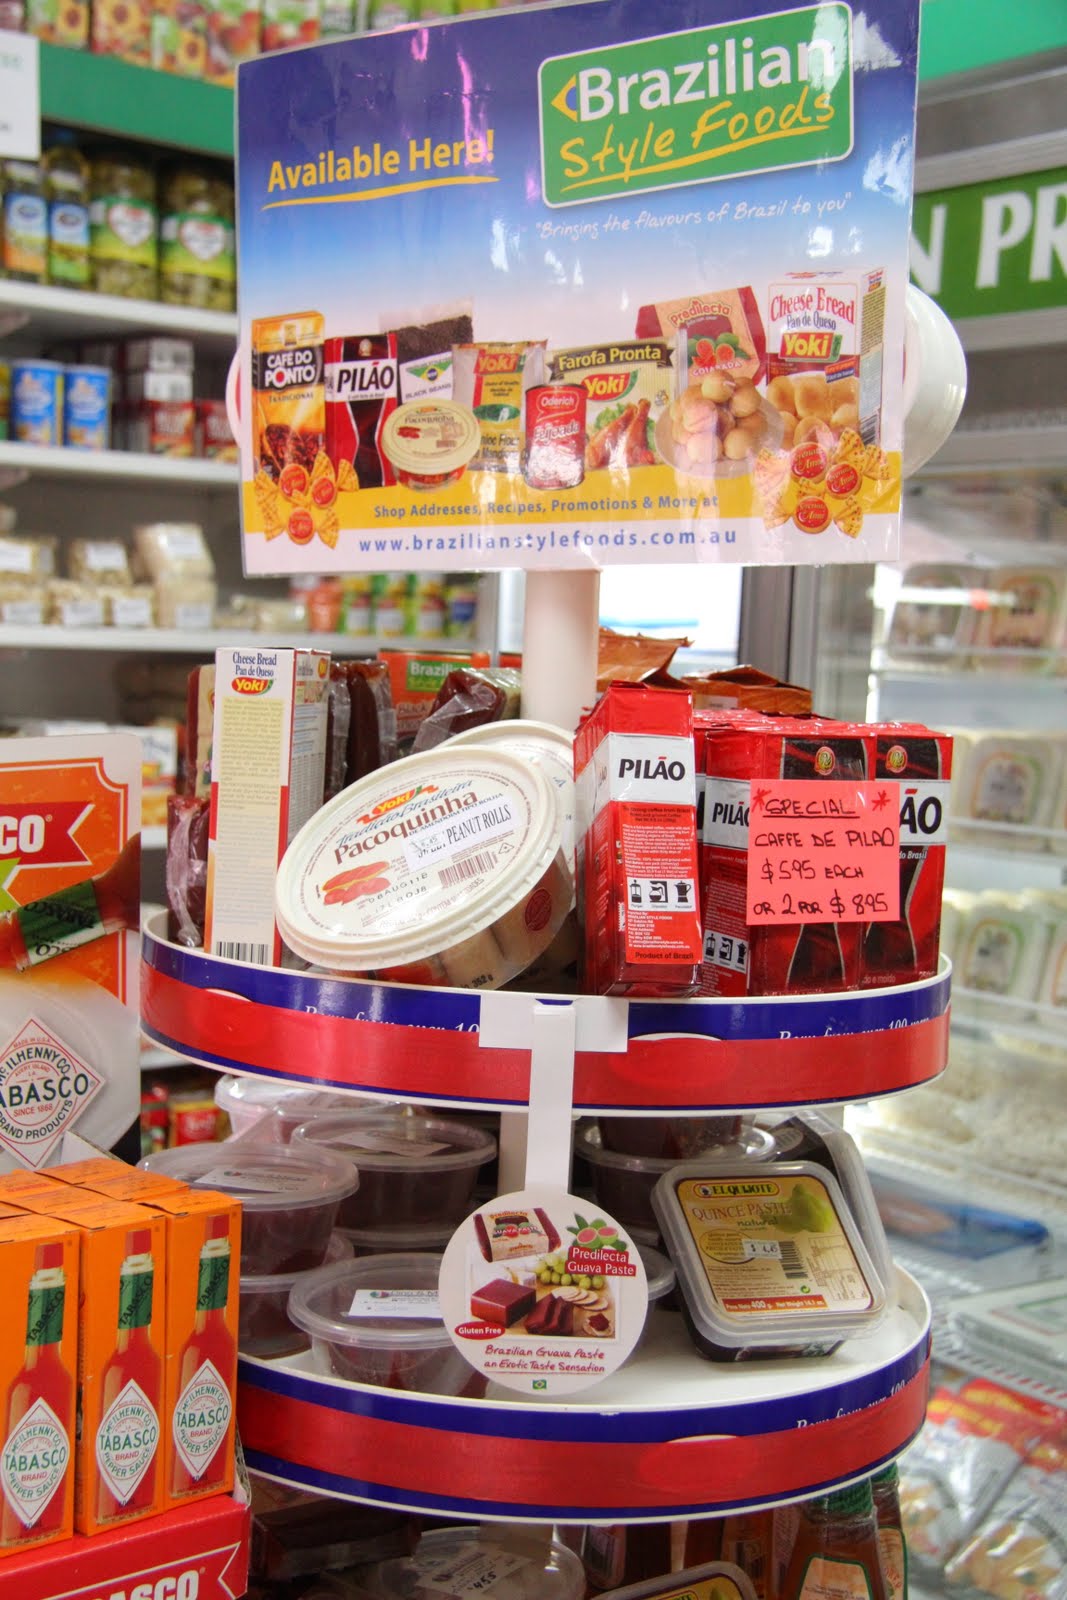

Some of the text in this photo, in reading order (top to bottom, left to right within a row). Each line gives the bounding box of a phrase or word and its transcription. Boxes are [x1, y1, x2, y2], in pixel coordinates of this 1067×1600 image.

[579, 36, 835, 121] Brazilian
[559, 85, 835, 183] Style Foods
[267, 128, 494, 193] Available Here!
[602, 213, 630, 232] the
[634, 209, 702, 229] flavours
[706, 202, 728, 222] of
[733, 197, 787, 220] Brazil
[791, 195, 811, 214] to
[669, 300, 731, 327] Predilecta
[770, 292, 814, 322] Cheese
[816, 286, 856, 325] Bread
[786, 312, 837, 331] Pan de Queso
[783, 334, 828, 358] Yoki
[294, 350, 313, 365] DO
[478, 353, 517, 373] Yoki
[559, 346, 662, 372] Farofa Pronta
[265, 364, 316, 389] PONTO
[585, 373, 626, 398] Yoki
[405, 389, 427, 400] BLACK
[374, 495, 718, 519] Shop Addresses, Recipes, Promotions & More at
[359, 529, 737, 552] www.brazilianstylefoods.com.au
[232, 651, 277, 666] Cheese Bread
[235, 664, 274, 677] Pan de Queso
[235, 678, 265, 692] Yoki
[378, 789, 413, 814] Yoki
[765, 798, 856, 815] SPECIAL
[446, 803, 513, 845] PEANUT ROLLS
[754, 832, 804, 847] CAFFE
[811, 830, 836, 847] DE
[907, 850, 927, 861] Brasil
[824, 864, 864, 879] EACH
[753, 901, 776, 916] OR
[781, 893, 796, 915] 2
[798, 900, 824, 915] FOR
[635, 951, 694, 960] Product of Brazil
[15, 1064, 51, 1077] AVERY ISLAND
[13, 1103, 54, 1118] SINCE 1868
[25, 1100, 73, 1140] PRODUCTS
[692, 1202, 793, 1222] QUINCE PASTE
[737, 1216, 780, 1227] natural
[572, 1247, 627, 1263] Predilecta
[567, 1260, 635, 1276] Guava Paste
[751, 1300, 766, 1309] 400
[458, 1326, 502, 1335] Gluten Free
[484, 1344, 605, 1360] Brazilian Guava Paste
[498, 1358, 529, 1370] Exotic
[529, 1360, 556, 1371] Taste
[558, 1361, 605, 1373] Sensation
[176, 1404, 229, 1428] TABASCO
[100, 1425, 157, 1452] TABASCO
[180, 1426, 222, 1454] PEPPER SAUCE
[190, 1427, 213, 1438] BRAND
[5, 1446, 66, 1472] TABASCO
[104, 1447, 150, 1477] PEPPER SAUCE
[115, 1450, 139, 1461] BRAND
[10, 1467, 60, 1498] PEPPER SAUCE
[21, 1471, 48, 1481] BRAND
